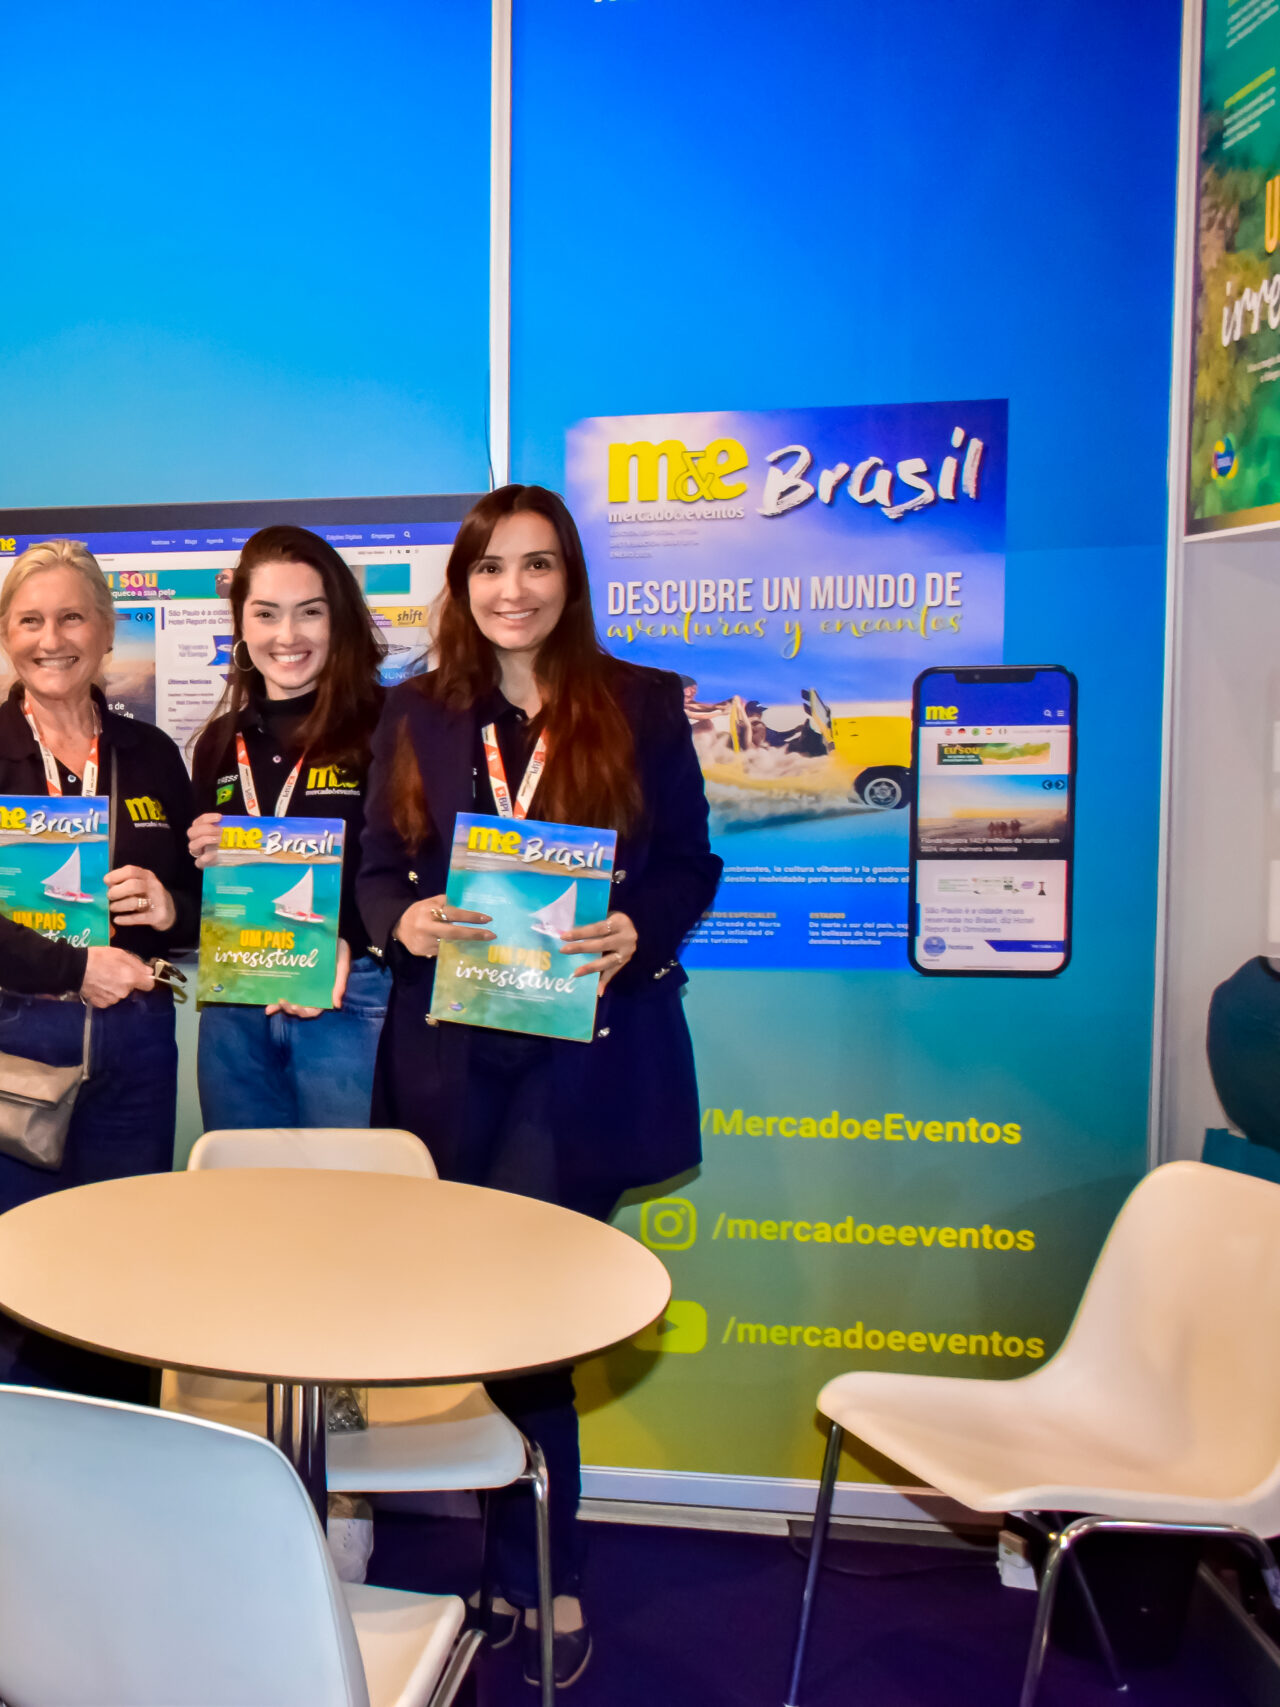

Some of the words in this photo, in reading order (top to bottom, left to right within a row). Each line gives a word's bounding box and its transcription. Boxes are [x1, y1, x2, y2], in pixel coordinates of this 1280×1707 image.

[608, 438, 749, 503] m&e
[757, 426, 985, 520] Brasil
[608, 507, 745, 523] mercado&eventos
[112, 590, 136, 599] quece
[608, 578, 753, 616] DESCUBRE
[762, 577, 802, 611] UN
[810, 573, 914, 610] MUNDO
[925, 572, 963, 607] DE
[397, 608, 423, 624] shift
[607, 607, 766, 644] aventuras
[782, 620, 803, 660] y
[820, 605, 965, 641] encantos
[29, 808, 101, 839] Brasil
[264, 830, 334, 859] Brasil
[521, 837, 604, 871] Brasil
[723, 865, 772, 873] umbrantes,
[784, 865, 815, 873] cultura
[816, 865, 852, 873] vibrante
[808, 876, 828, 884] para
[240, 930, 262, 948] UM
[878, 930, 909, 938] principa
[700, 1108, 1022, 1145] /MercadoeEventos
[712, 1212, 1036, 1252] /mercadoeeventos
[722, 1316, 1045, 1360] /mercadoeeventos
